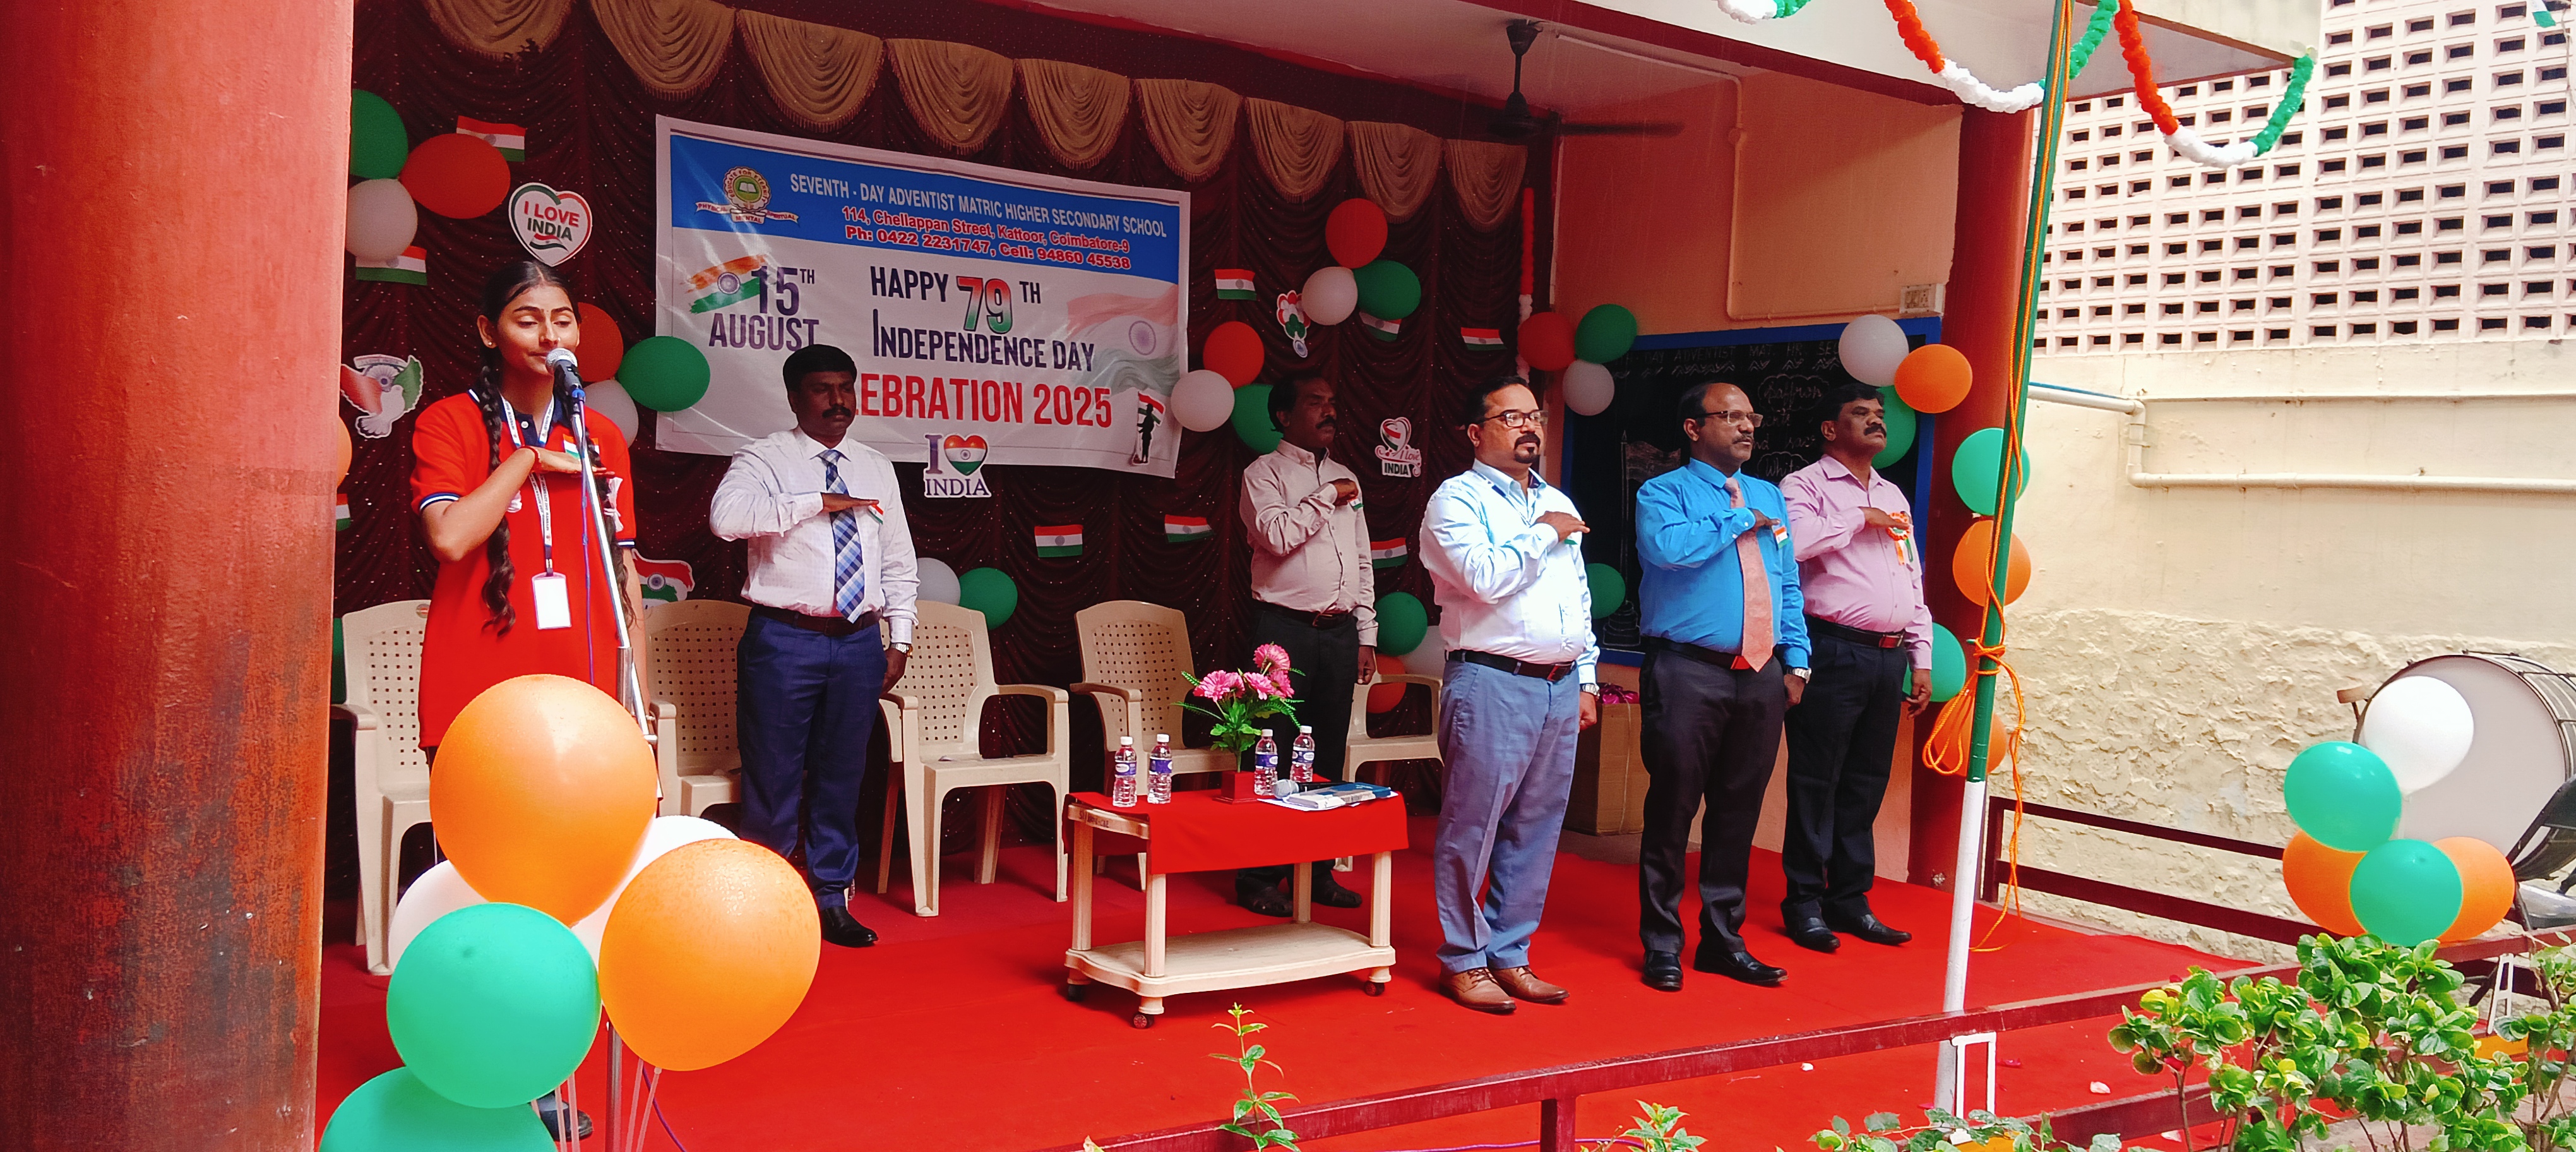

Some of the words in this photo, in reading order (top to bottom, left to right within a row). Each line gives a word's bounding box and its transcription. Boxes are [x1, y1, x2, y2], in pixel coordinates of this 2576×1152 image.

[727, 172, 737, 198] EDUCATE
[754, 174, 766, 203] ETERNITY
[790, 173, 849, 198] SEVENTH
[860, 183, 884, 203] DAY
[889, 187, 955, 212] ADVENTIST
[958, 195, 1002, 218] MATRIC
[1005, 203, 1049, 223] HIGHER
[1052, 209, 1119, 231] SECONDARY
[1123, 215, 1167, 237] SCHOOL
[524, 201, 529, 215] I
[534, 203, 580, 227] LOVE
[527, 217, 573, 242] INDIA
[842, 206, 870, 225] 114,
[873, 209, 949, 233] Chellappan
[952, 219, 994, 239] Street,
[997, 224, 1047, 246] Kattoor,
[1049, 231, 1130, 253] Coimbatore-9
[845, 225, 873, 241] Ph:
[877, 229, 919, 246] 0422
[922, 234, 996, 256] 2231747,
[999, 243, 1032, 259] Cell:
[1037, 248, 1083, 264] 94860
[1087, 253, 1131, 270] 45538
[870, 266, 948, 303] HAPPY
[956, 275, 1013, 335] 79
[1019, 280, 1041, 304] TH
[709, 313, 819, 351] AUGUST
[873, 308, 1047, 369] INDEPENDENCE
[1052, 340, 1094, 372] DAY
[1674, 346, 1736, 362] ADVENTIST
[856, 373, 1023, 424] EBRATION
[1033, 383, 1112, 428] 2025
[925, 435, 943, 474] I
[1385, 463, 1409, 475] INDIA
[925, 478, 989, 496] INDIA
